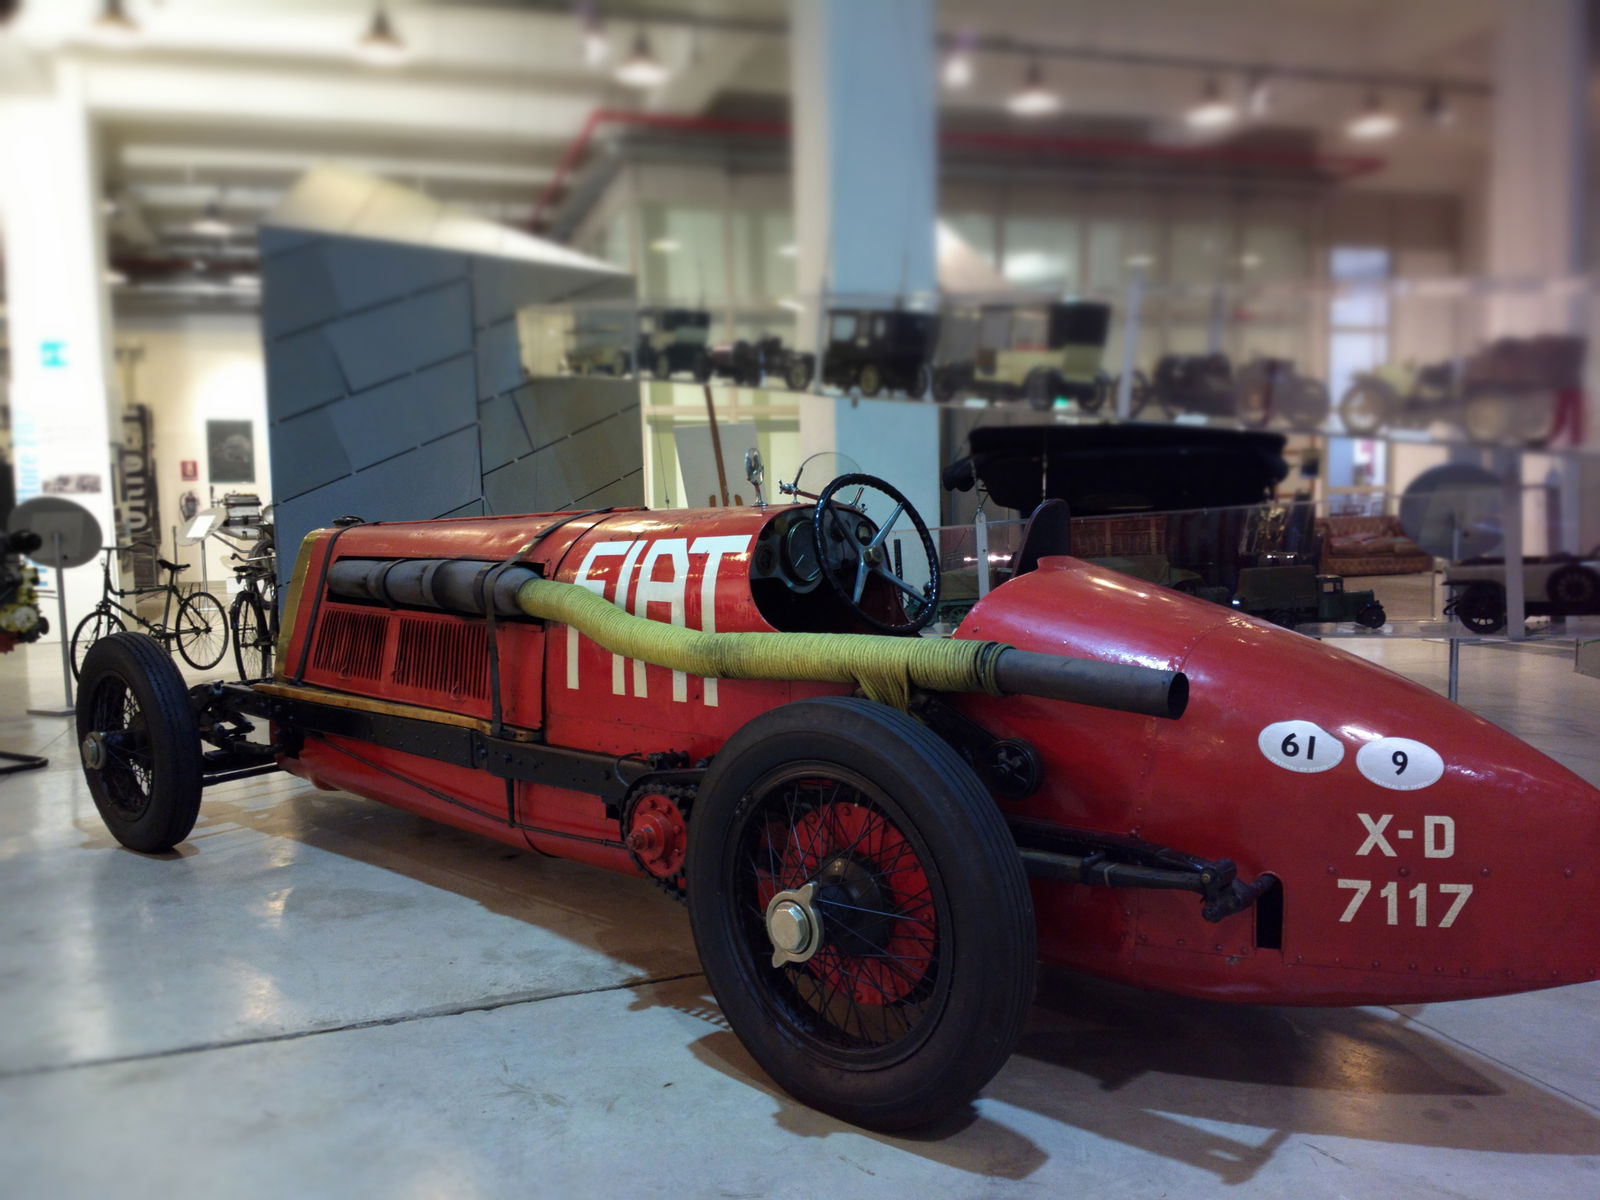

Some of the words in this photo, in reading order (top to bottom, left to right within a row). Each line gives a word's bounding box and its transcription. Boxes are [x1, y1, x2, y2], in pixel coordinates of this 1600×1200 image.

[567, 534, 752, 707] FIAT
[1281, 733, 1316, 760] 61
[1392, 750, 1408, 775] 9
[1337, 878, 1473, 928] 7117
